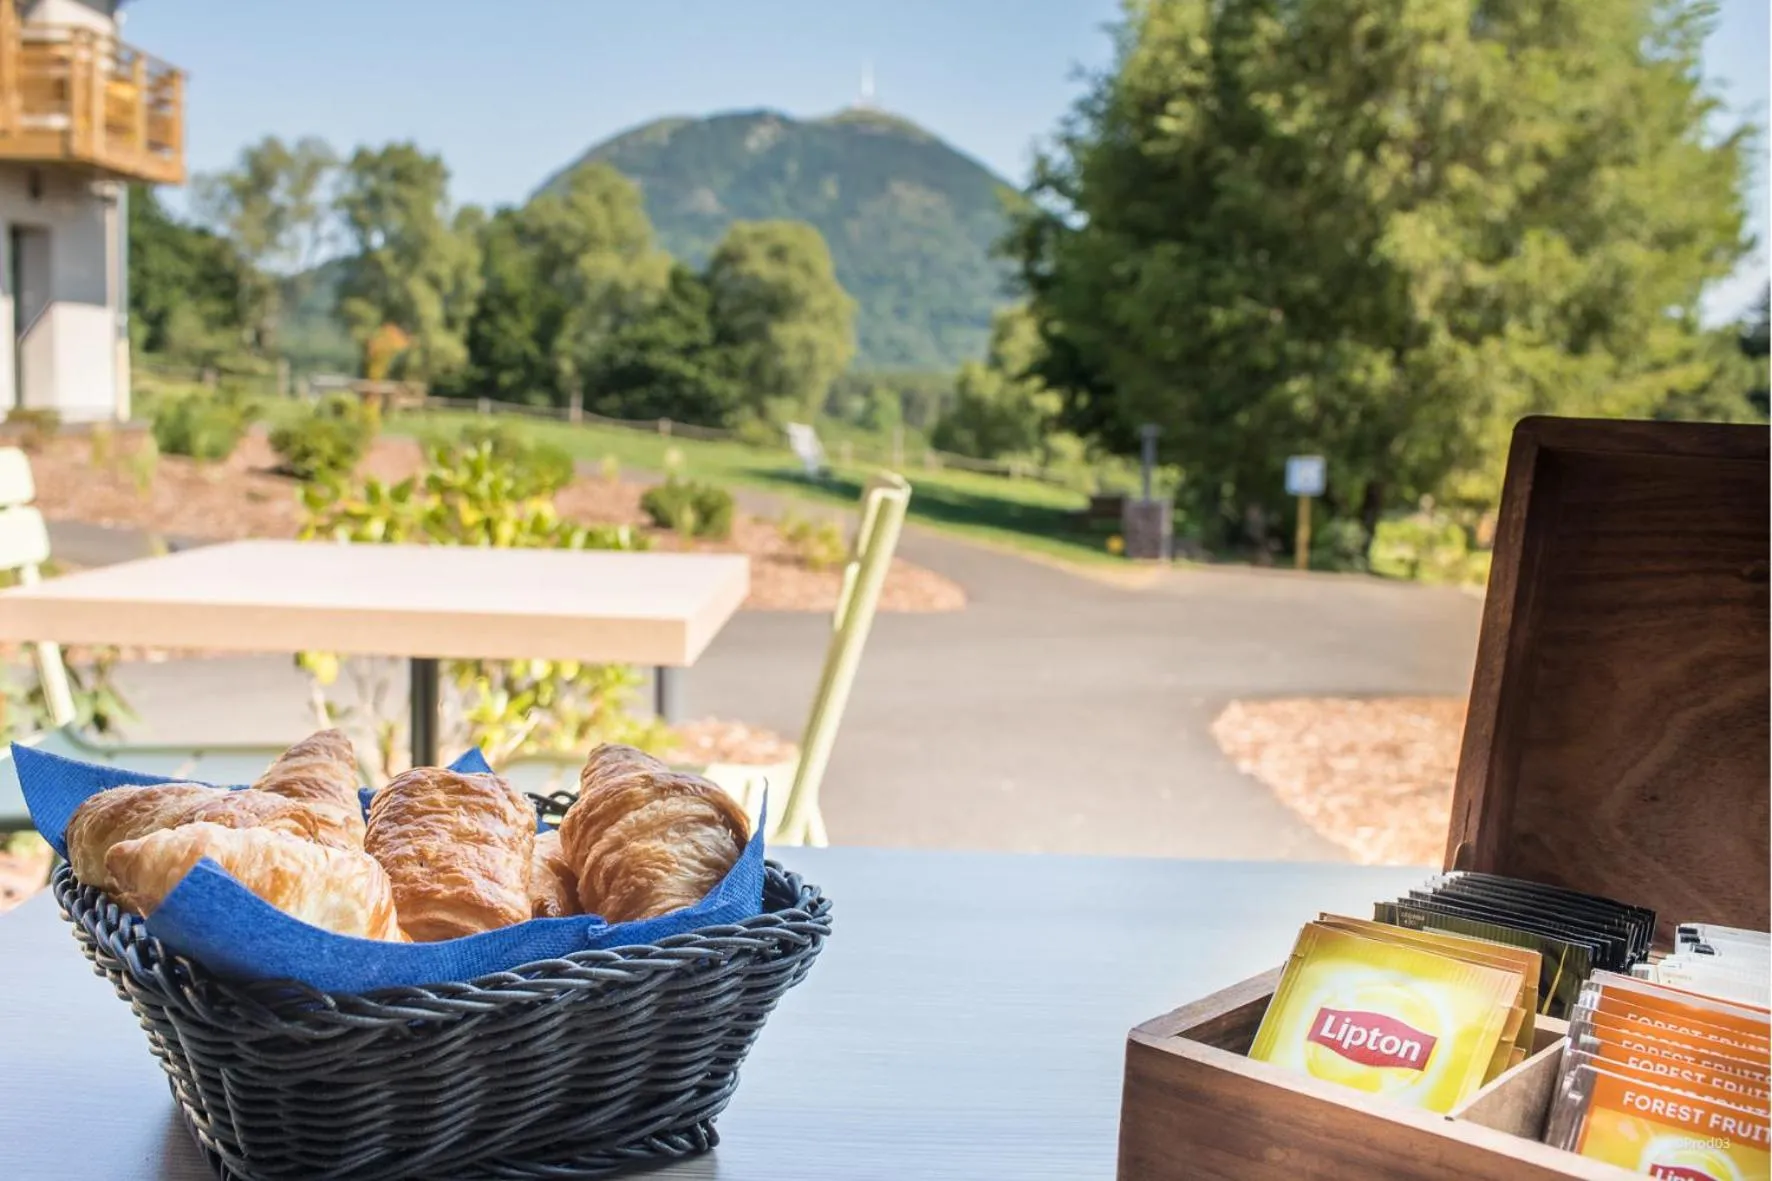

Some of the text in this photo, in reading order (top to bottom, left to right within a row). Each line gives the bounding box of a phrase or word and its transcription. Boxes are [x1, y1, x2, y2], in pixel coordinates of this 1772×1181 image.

[1320, 1014, 1421, 1062] Lipton
[1628, 1056, 1706, 1084] FOREST
[1623, 1091, 1705, 1124] FOREST
